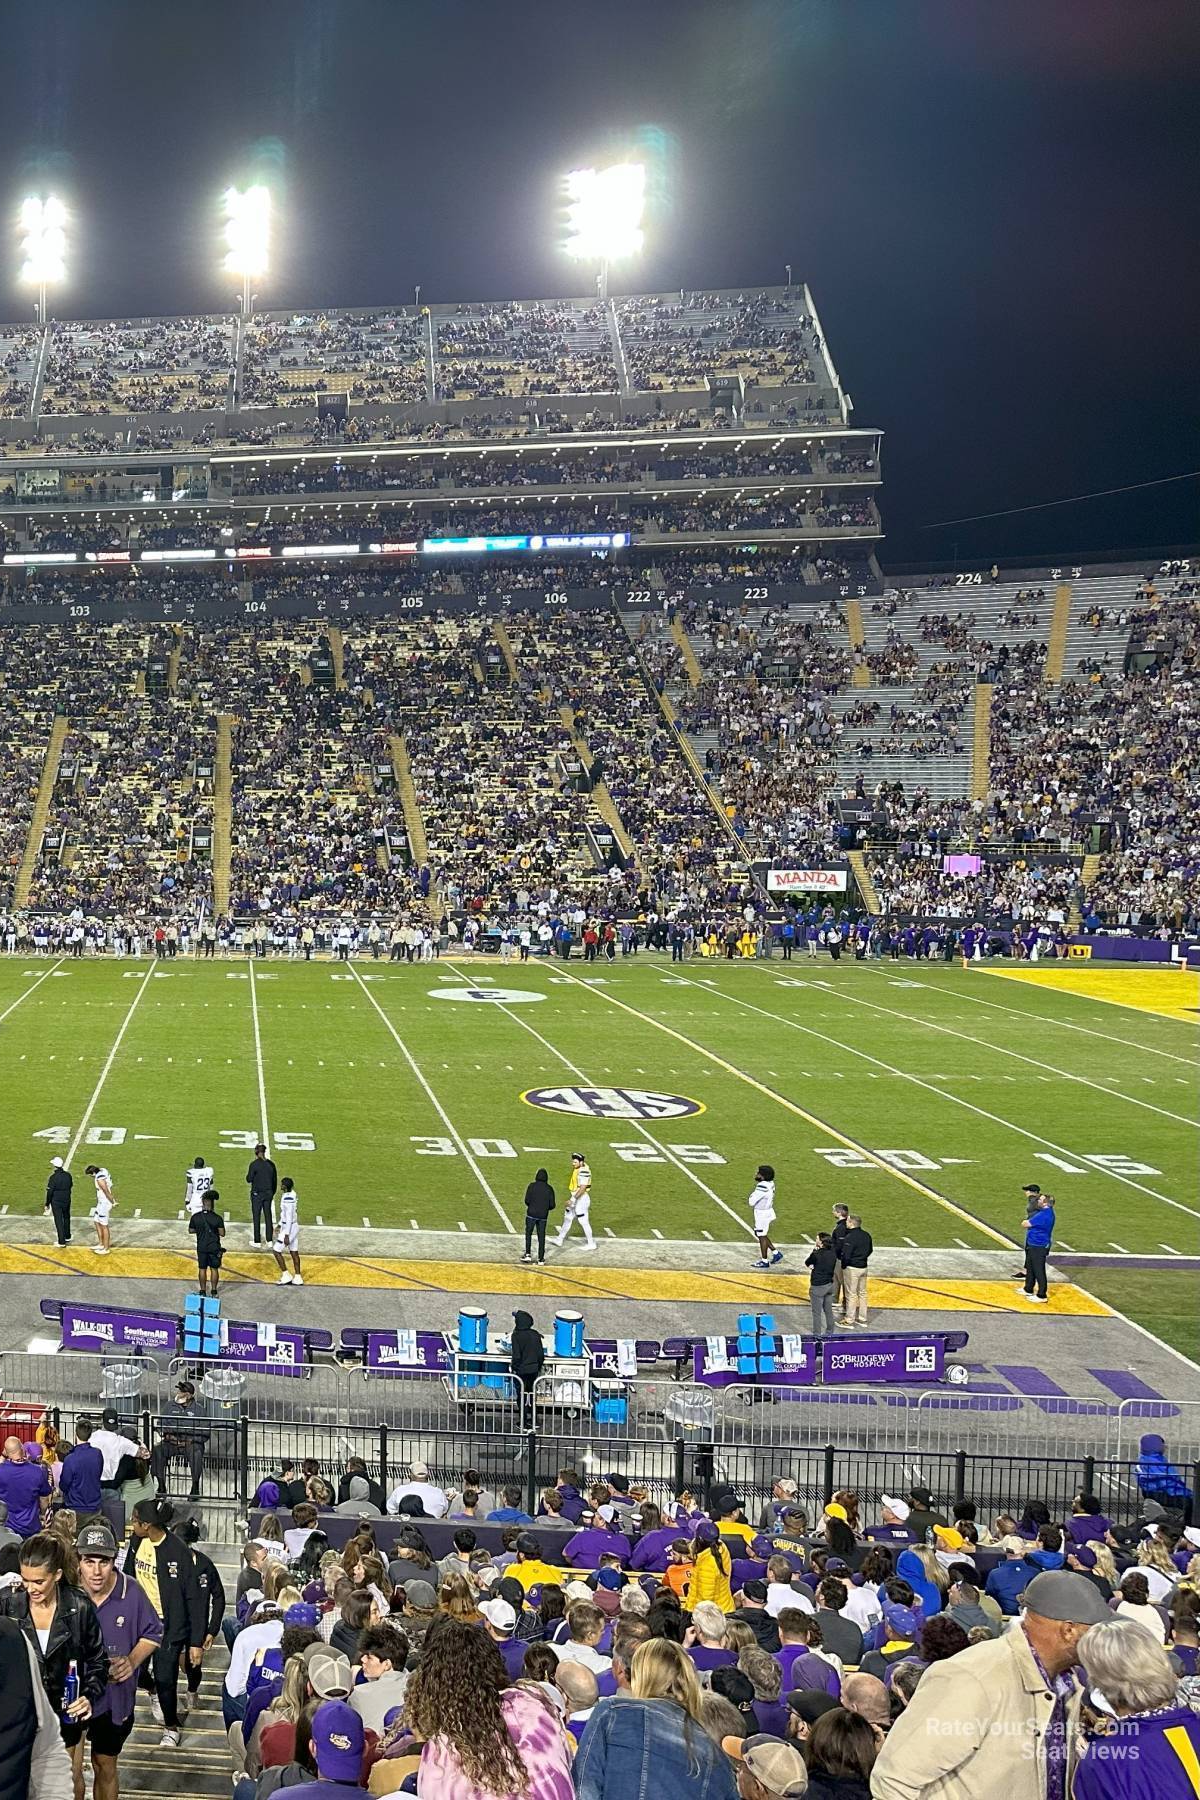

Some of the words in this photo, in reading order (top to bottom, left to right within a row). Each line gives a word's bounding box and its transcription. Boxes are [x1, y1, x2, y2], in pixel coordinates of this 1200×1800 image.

[955, 572, 982, 586] 224
[544, 592, 568, 604] 106
[626, 590, 650, 603] 222
[744, 587, 768, 600] 223
[243, 601, 267, 613] 104
[400, 596, 424, 608] 105
[69, 605, 90, 617] 103
[775, 871, 839, 887] MANDA
[32, 1126, 127, 1145] 40
[218, 1130, 317, 1152] 35
[409, 1136, 518, 1158] 30
[609, 1142, 728, 1164] 25
[812, 1147, 943, 1171] 20
[1032, 1152, 1163, 1175] 15
[196, 1178, 210, 1191] 23
[72, 1319, 114, 1335] WALK-ON'S
[123, 1326, 169, 1340] SouthernAIR
[844, 1353, 896, 1364] BRIDGEWAY
